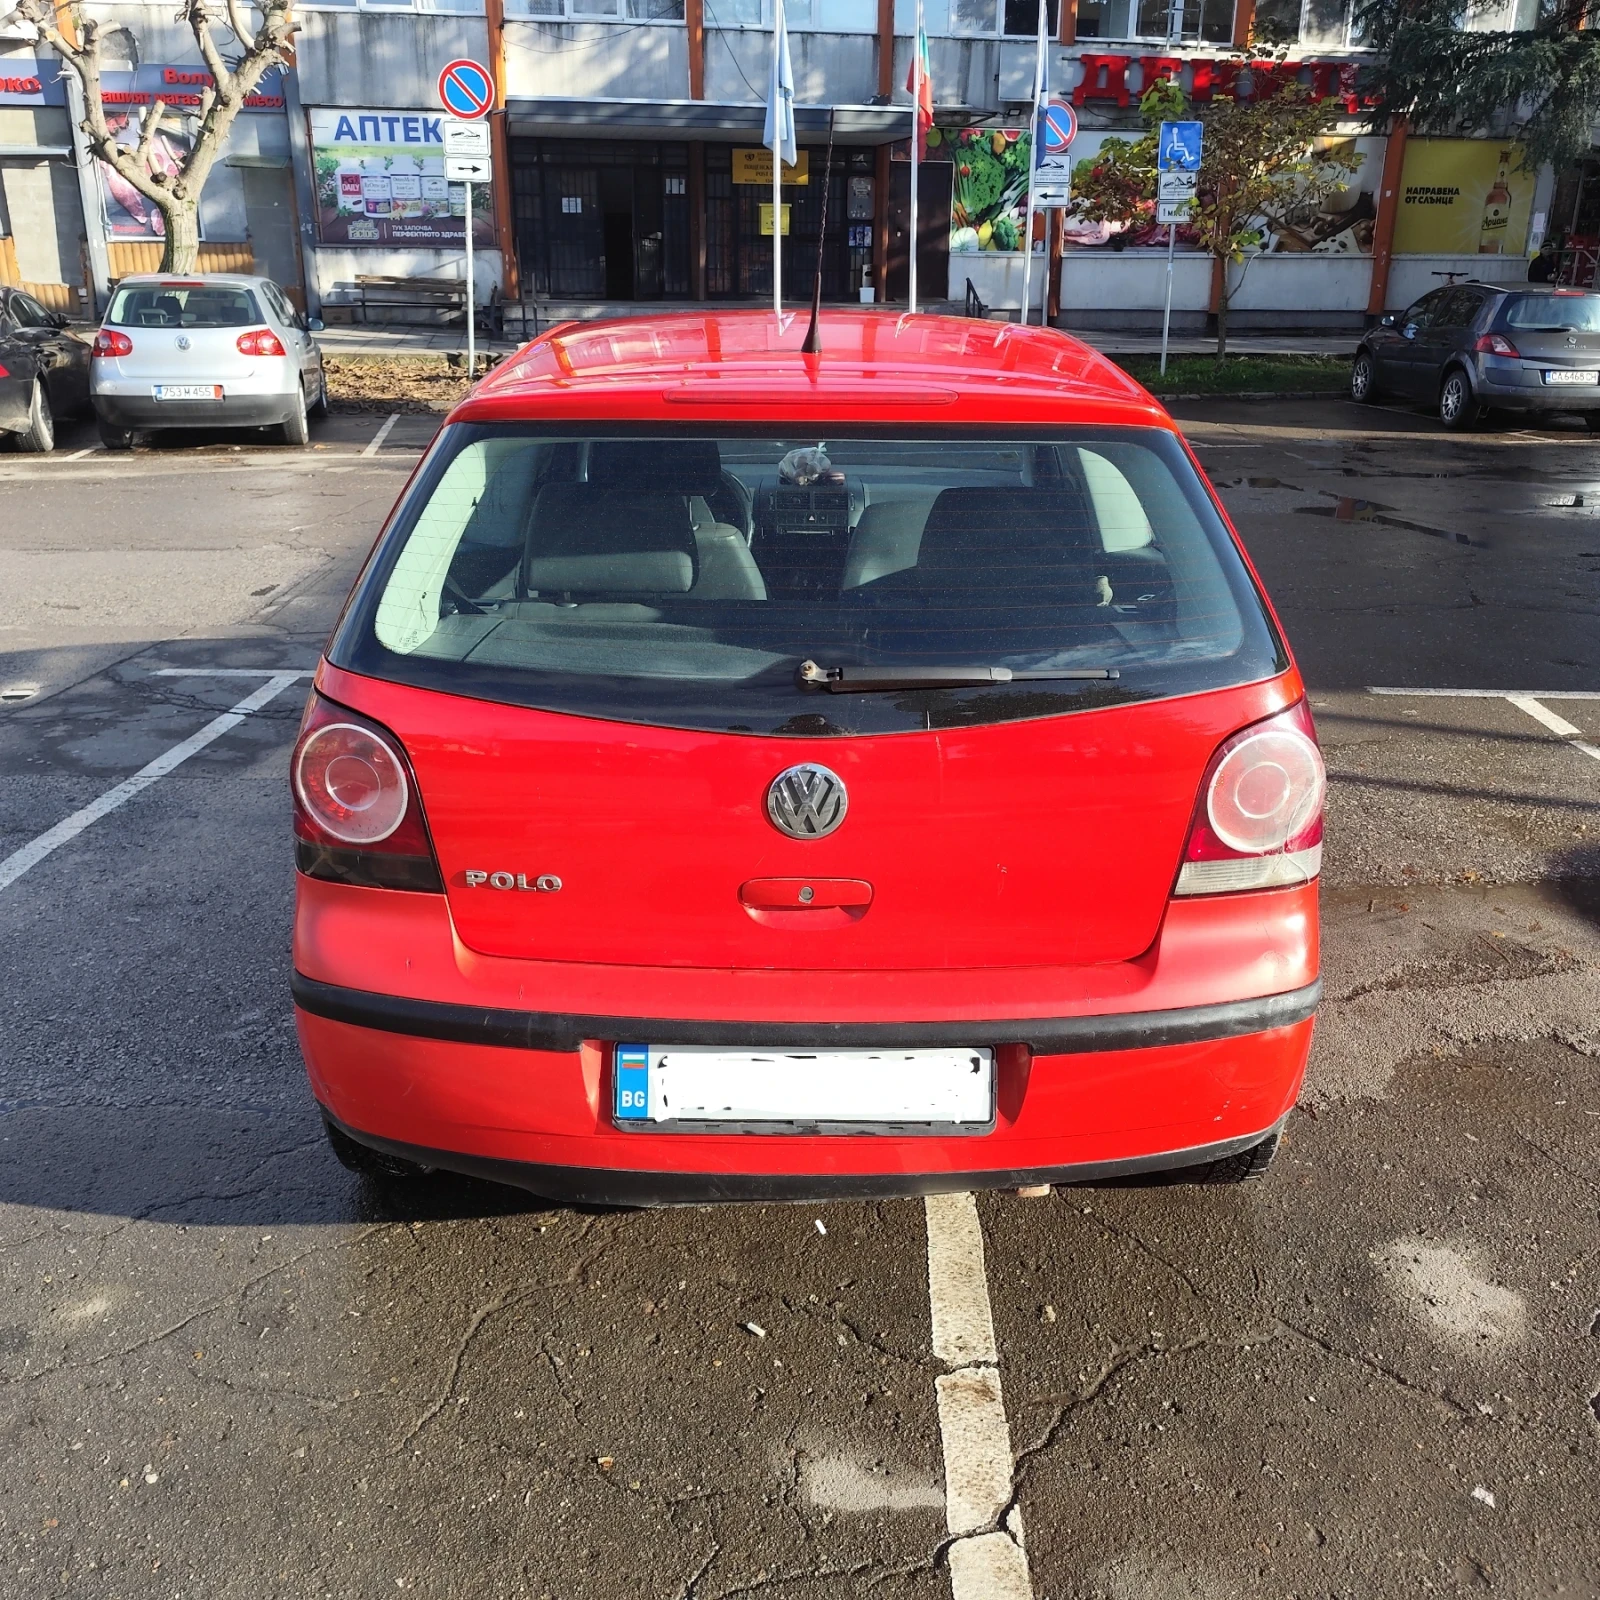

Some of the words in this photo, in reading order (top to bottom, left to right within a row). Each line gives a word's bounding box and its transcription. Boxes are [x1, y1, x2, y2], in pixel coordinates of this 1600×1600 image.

[334, 115, 443, 143] АПТЕК
[342, 184, 360, 192] DAILY
[1406, 187, 1460, 196] НАПРАВЕНА
[1405, 196, 1417, 204] ОТ
[1418, 196, 1454, 205] СЛЪНЦЕ
[163, 387, 182, 398] 753
[193, 387, 212, 397] 455
[465, 869, 563, 893] POLO
[621, 1090, 645, 1108] BG
